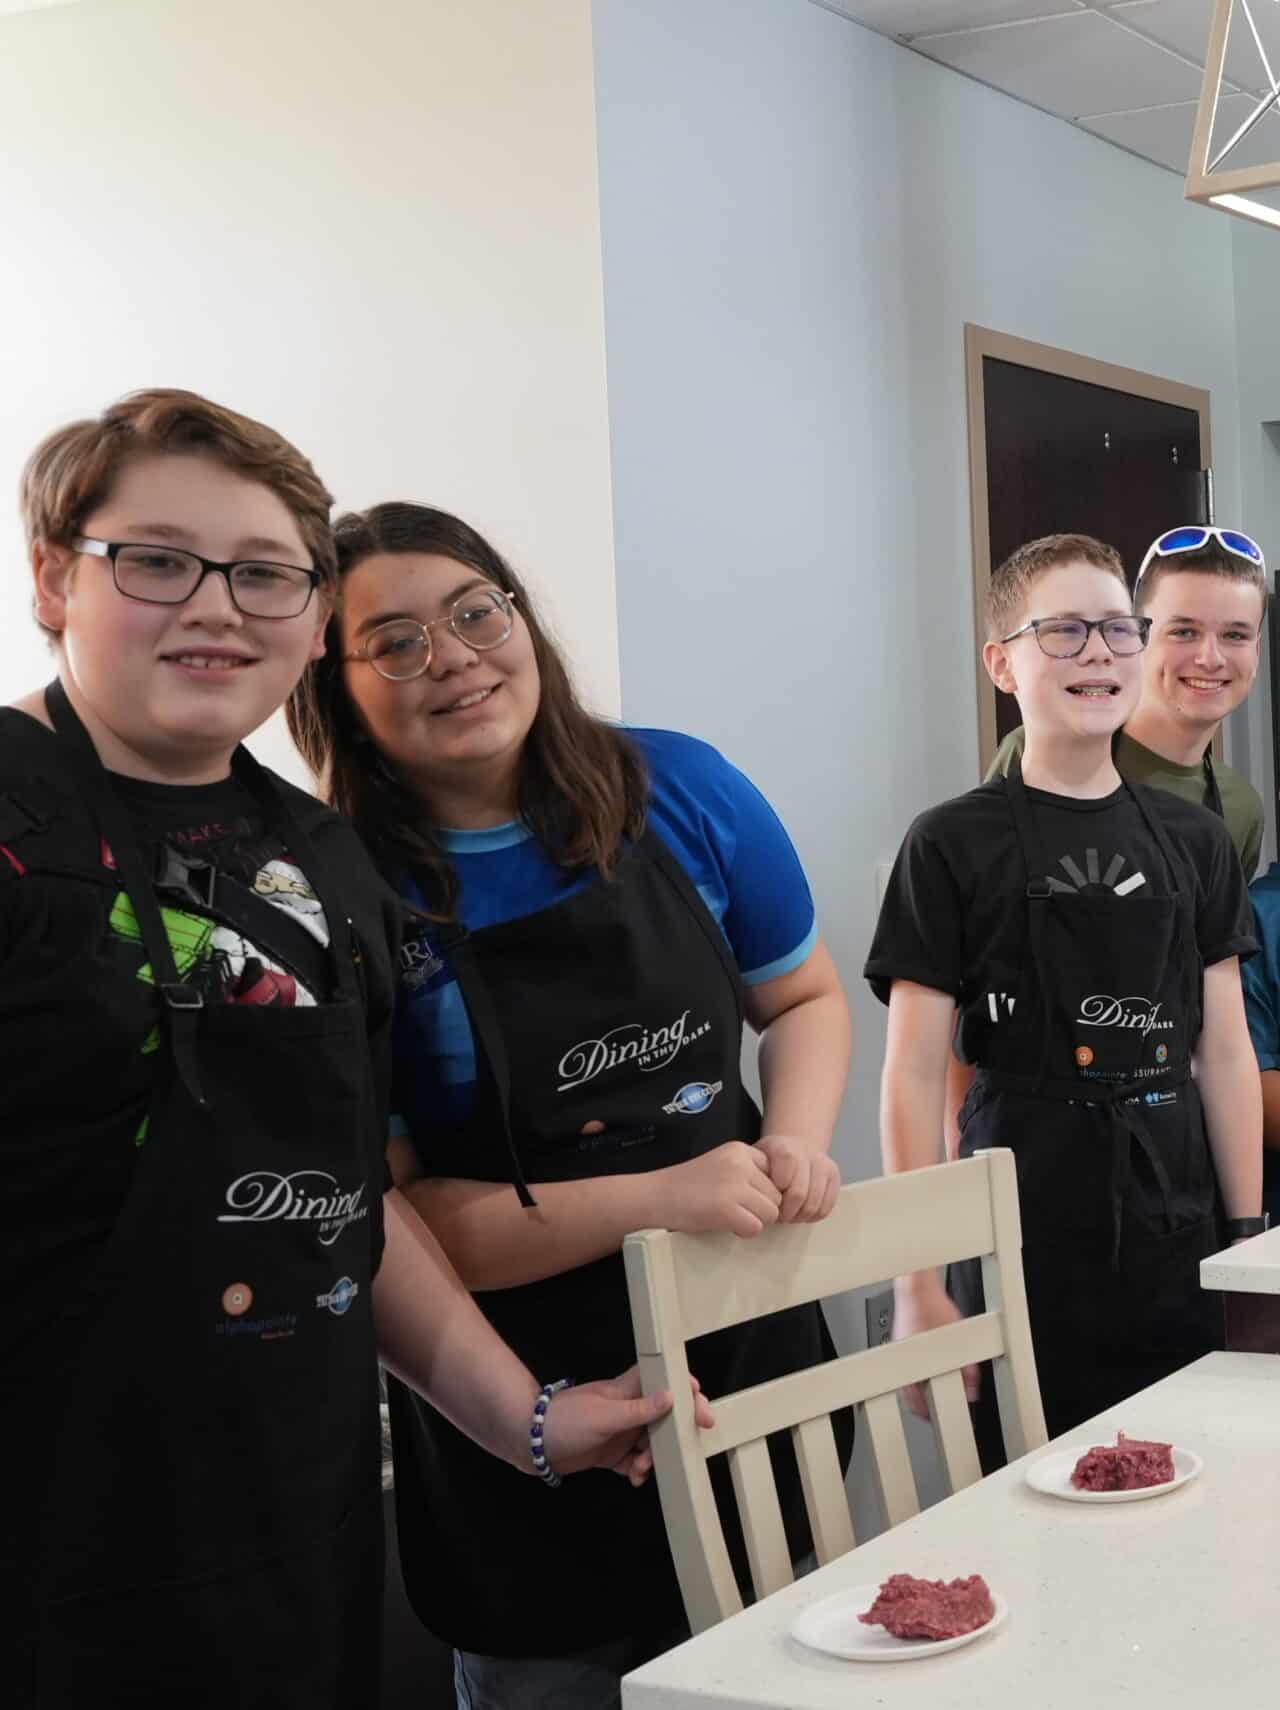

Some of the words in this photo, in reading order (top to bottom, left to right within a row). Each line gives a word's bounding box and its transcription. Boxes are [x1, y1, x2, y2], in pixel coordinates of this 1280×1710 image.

[557, 1009, 691, 1092] Dining
[638, 1055, 651, 1066] IN
[653, 1042, 674, 1058] THE
[682, 1019, 711, 1046] DARK
[216, 1169, 367, 1246] Dining
